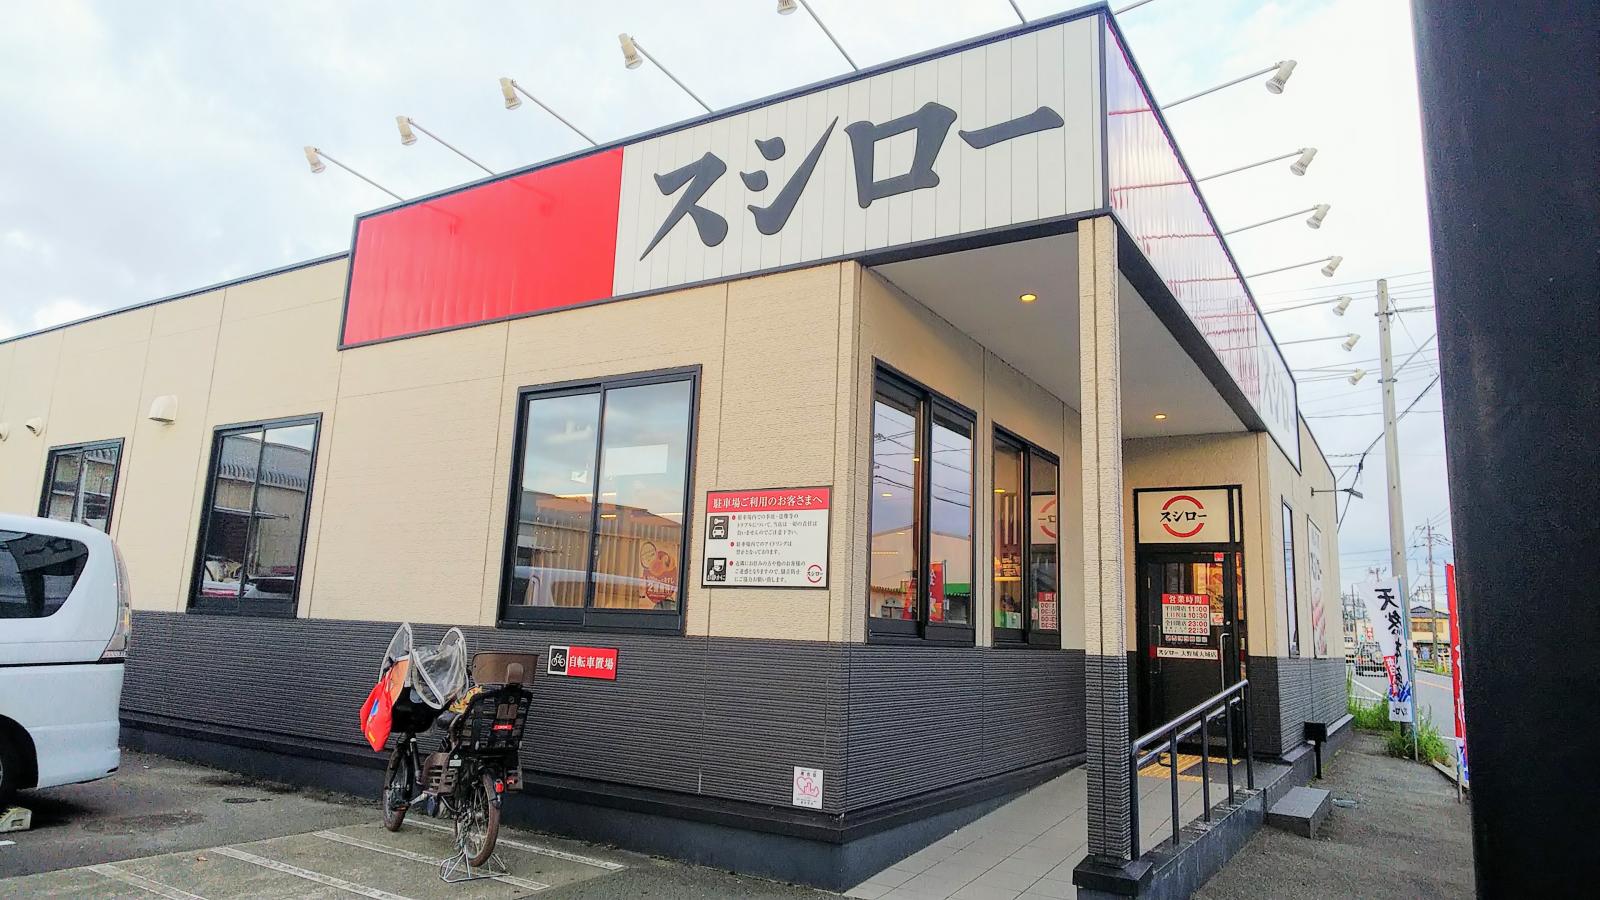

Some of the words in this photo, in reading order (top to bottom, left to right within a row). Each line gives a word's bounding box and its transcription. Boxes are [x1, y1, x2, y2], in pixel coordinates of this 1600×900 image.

[639, 101, 1064, 262] スシロー
[712, 494, 823, 509] 駐車場ご利用のお客さまへ
[1160, 510, 1207, 523] スシロー
[1169, 595, 1202, 604] 営業時間
[569, 655, 614, 671] 自転車置場
